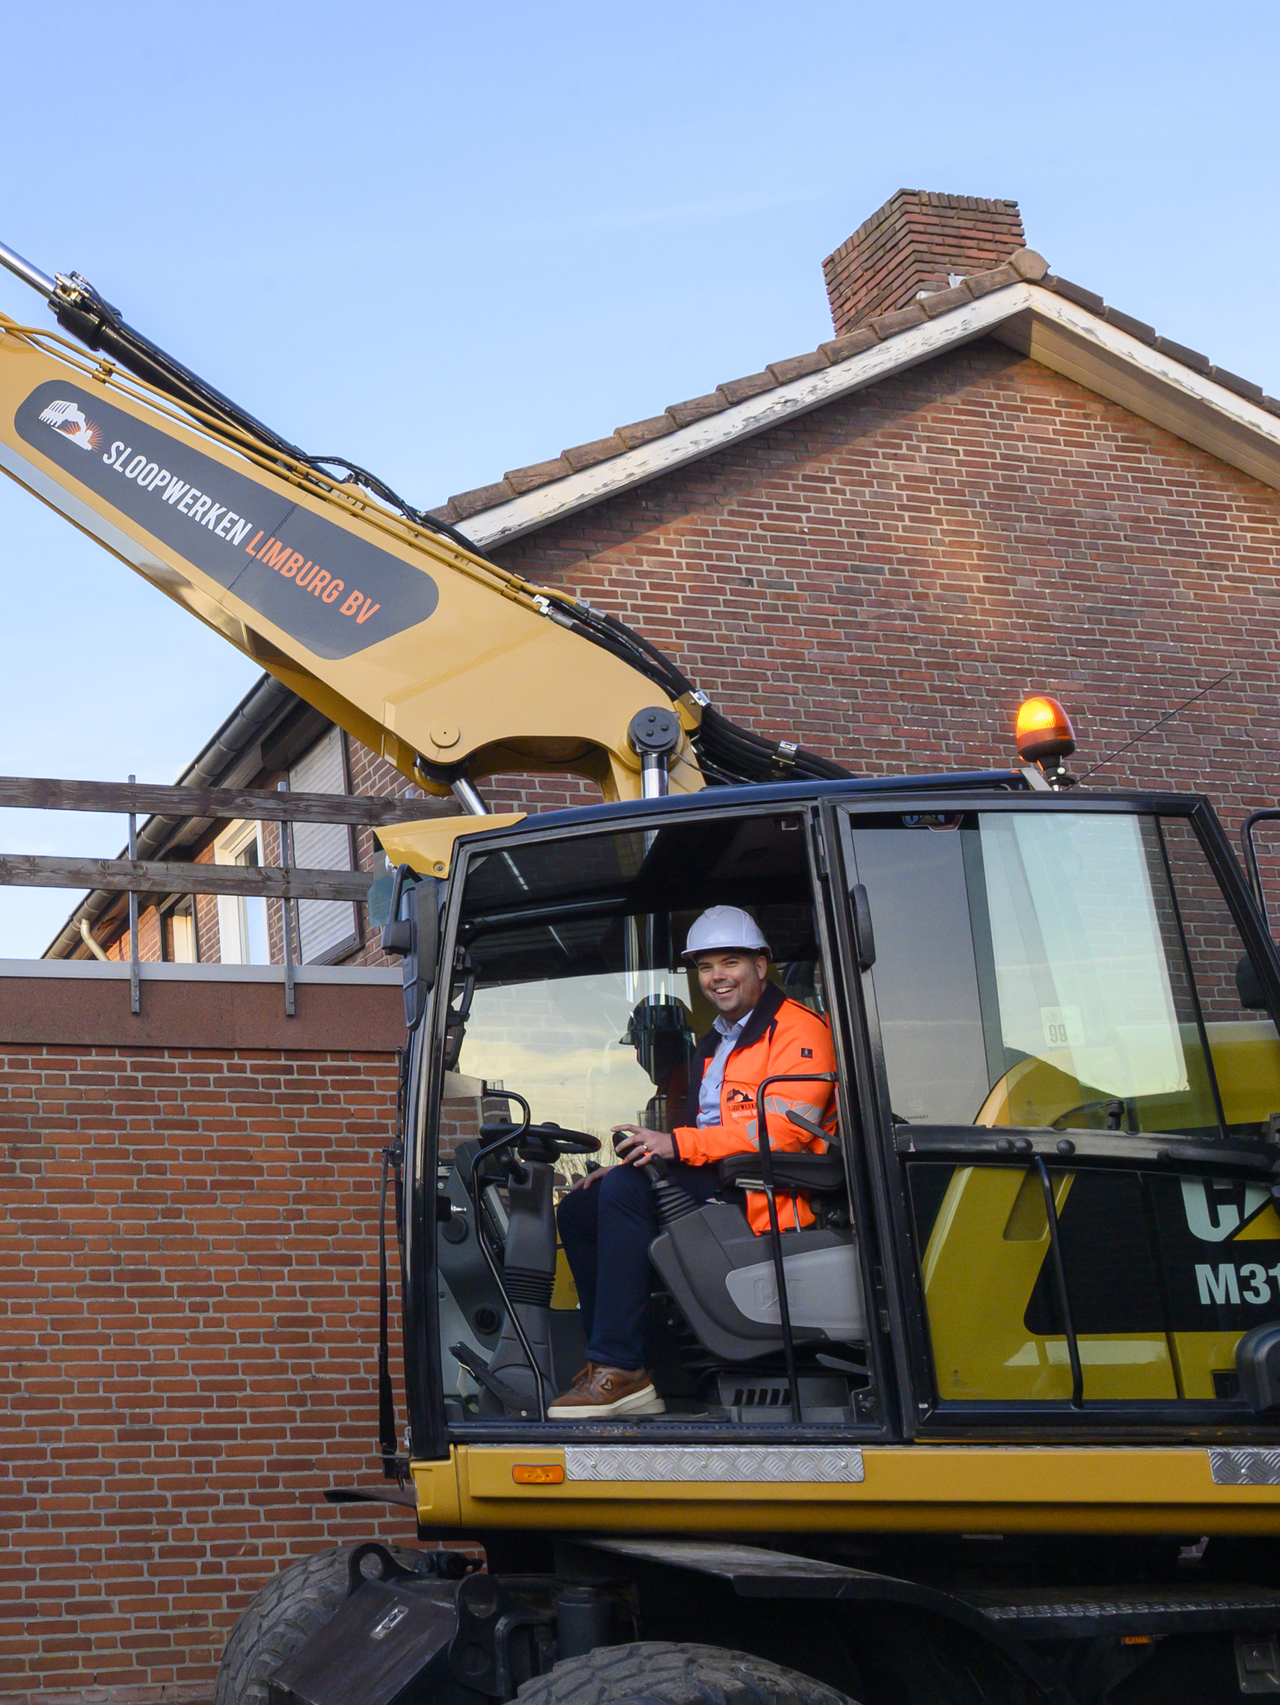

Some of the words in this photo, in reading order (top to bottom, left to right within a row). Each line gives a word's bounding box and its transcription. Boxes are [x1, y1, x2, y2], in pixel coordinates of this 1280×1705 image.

[103, 441, 253, 547] SLOOPWERKEN
[245, 530, 344, 604] LIMBURG
[339, 590, 381, 625] BV
[1048, 1024, 1068, 1043] 99
